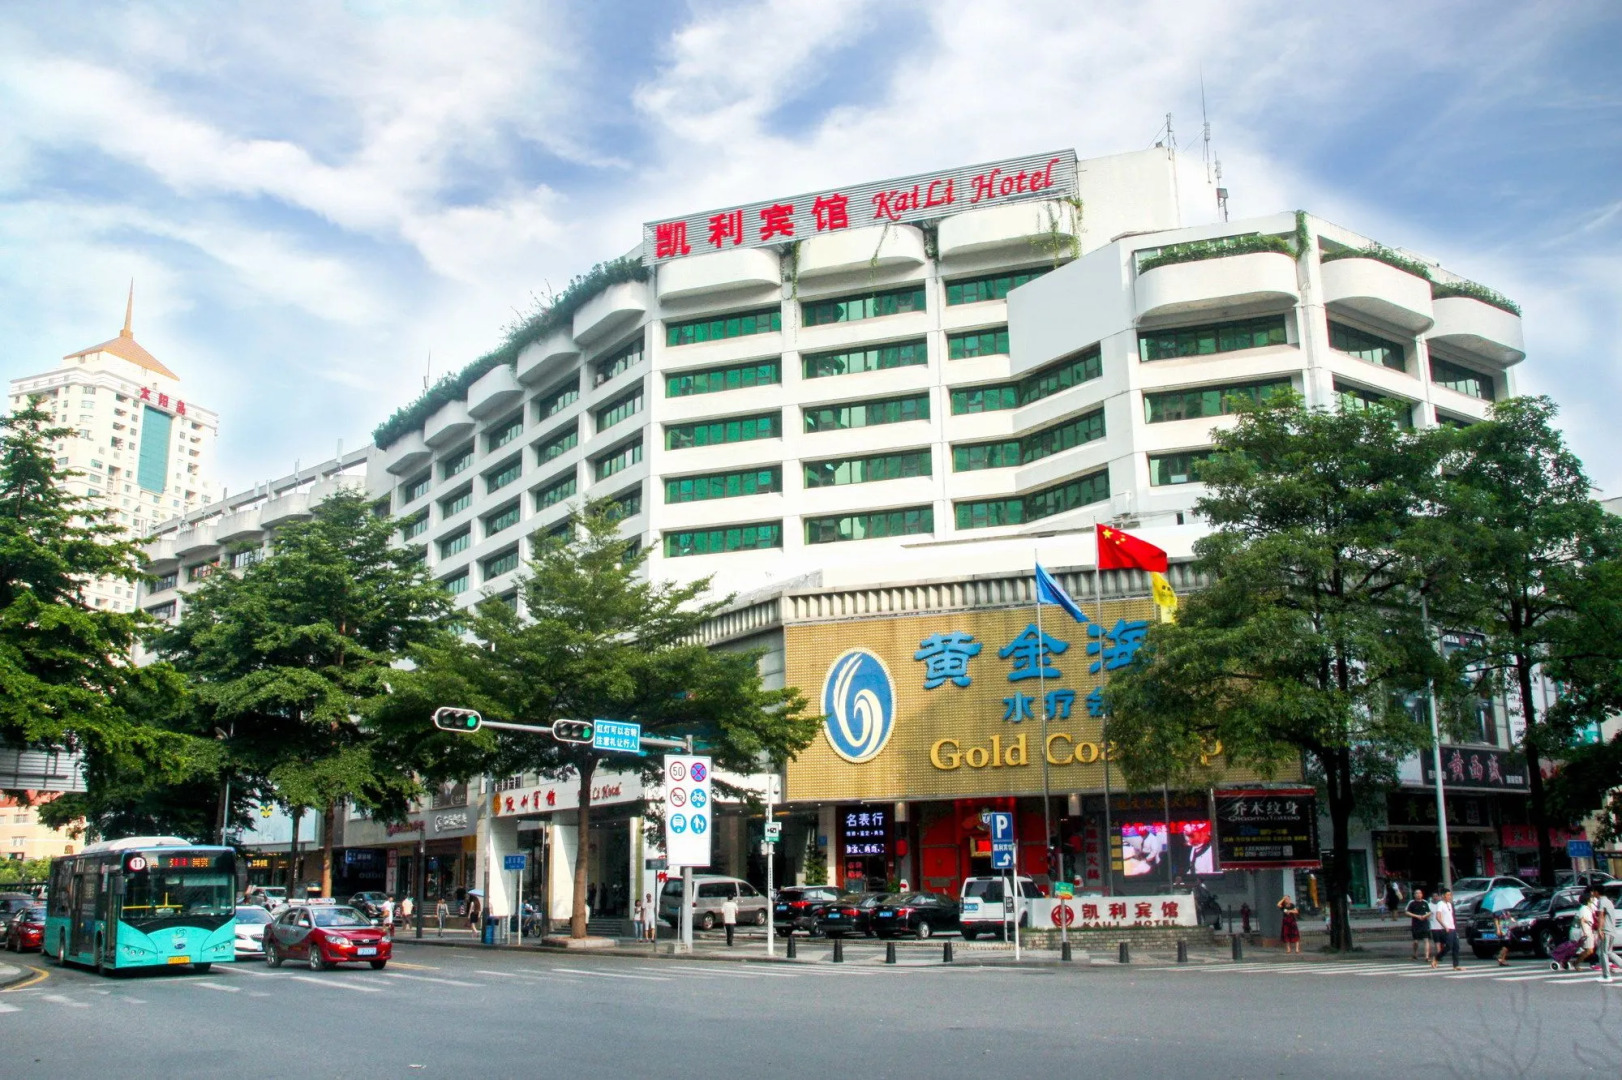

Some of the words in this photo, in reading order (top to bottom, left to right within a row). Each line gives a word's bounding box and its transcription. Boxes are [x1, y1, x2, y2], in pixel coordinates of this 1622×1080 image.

[970, 158, 1059, 204] Hotel
[656, 193, 848, 258] 凯利宾馆
[597, 724, 637, 736] 红灯可以右转
[596, 736, 637, 749] 注意礼让行人
[930, 733, 1029, 770] Gold
[1045, 733, 1118, 765] Coa
[672, 766, 682, 776] 50
[1233, 801, 1299, 815] 乔木纹身
[846, 812, 883, 827] 名表行
[996, 815, 1008, 839] P
[134, 859, 143, 868] 11
[1081, 901, 1179, 919] 凯利宾馆
